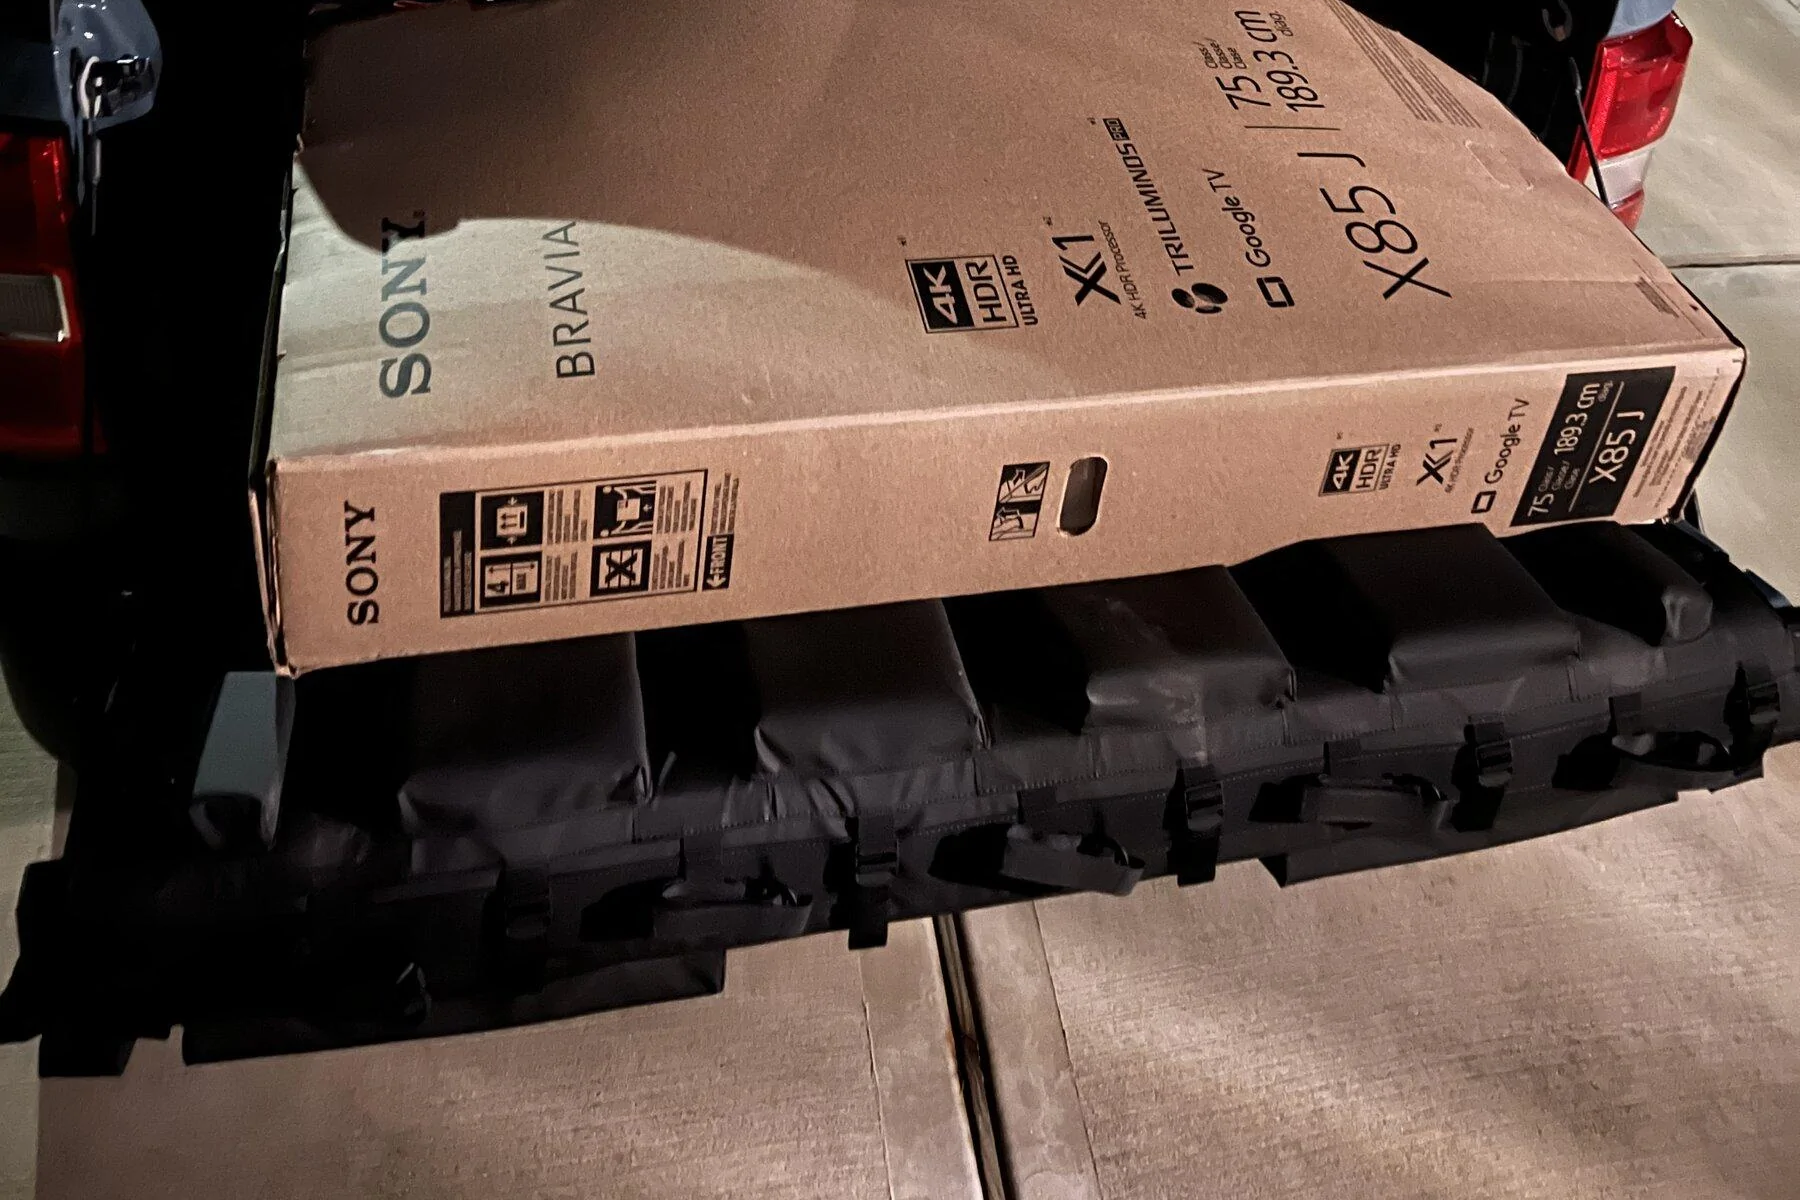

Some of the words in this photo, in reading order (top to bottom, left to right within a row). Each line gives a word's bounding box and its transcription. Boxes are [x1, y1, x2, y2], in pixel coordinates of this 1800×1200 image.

[1234, 10, 1278, 42] cm
[1227, 46, 1248, 70] Clase
[1214, 75, 1272, 111] 75
[1252, 50, 1326, 113] 189.3
[1105, 119, 1129, 141] PRO
[1201, 168, 1232, 193] TV
[1115, 142, 1195, 277] TRILUMINOS
[1221, 195, 1272, 268] Google
[1002, 254, 1022, 276] HD
[1097, 220, 1130, 273] Processor
[964, 259, 1008, 323] HDR
[1051, 234, 1122, 307] X1
[1120, 273, 1141, 302] HDR
[378, 216, 432, 399] SONY
[541, 220, 596, 379] BRAVIA
[922, 264, 958, 325] 4K
[1012, 280, 1039, 326] ULTRA
[1131, 301, 1148, 320] 4K
[1576, 382, 1600, 410] cm
[1415, 438, 1458, 486] X1
[1484, 423, 1522, 485] Google
[1508, 398, 1530, 421] TV
[1332, 452, 1354, 490] 4K
[1355, 448, 1382, 489] HDR
[1378, 459, 1396, 490] ULTRA
[1389, 444, 1402, 458] HD
[1527, 493, 1555, 517] 75
[344, 500, 380, 626] SONY
[709, 535, 728, 576] FRONT
